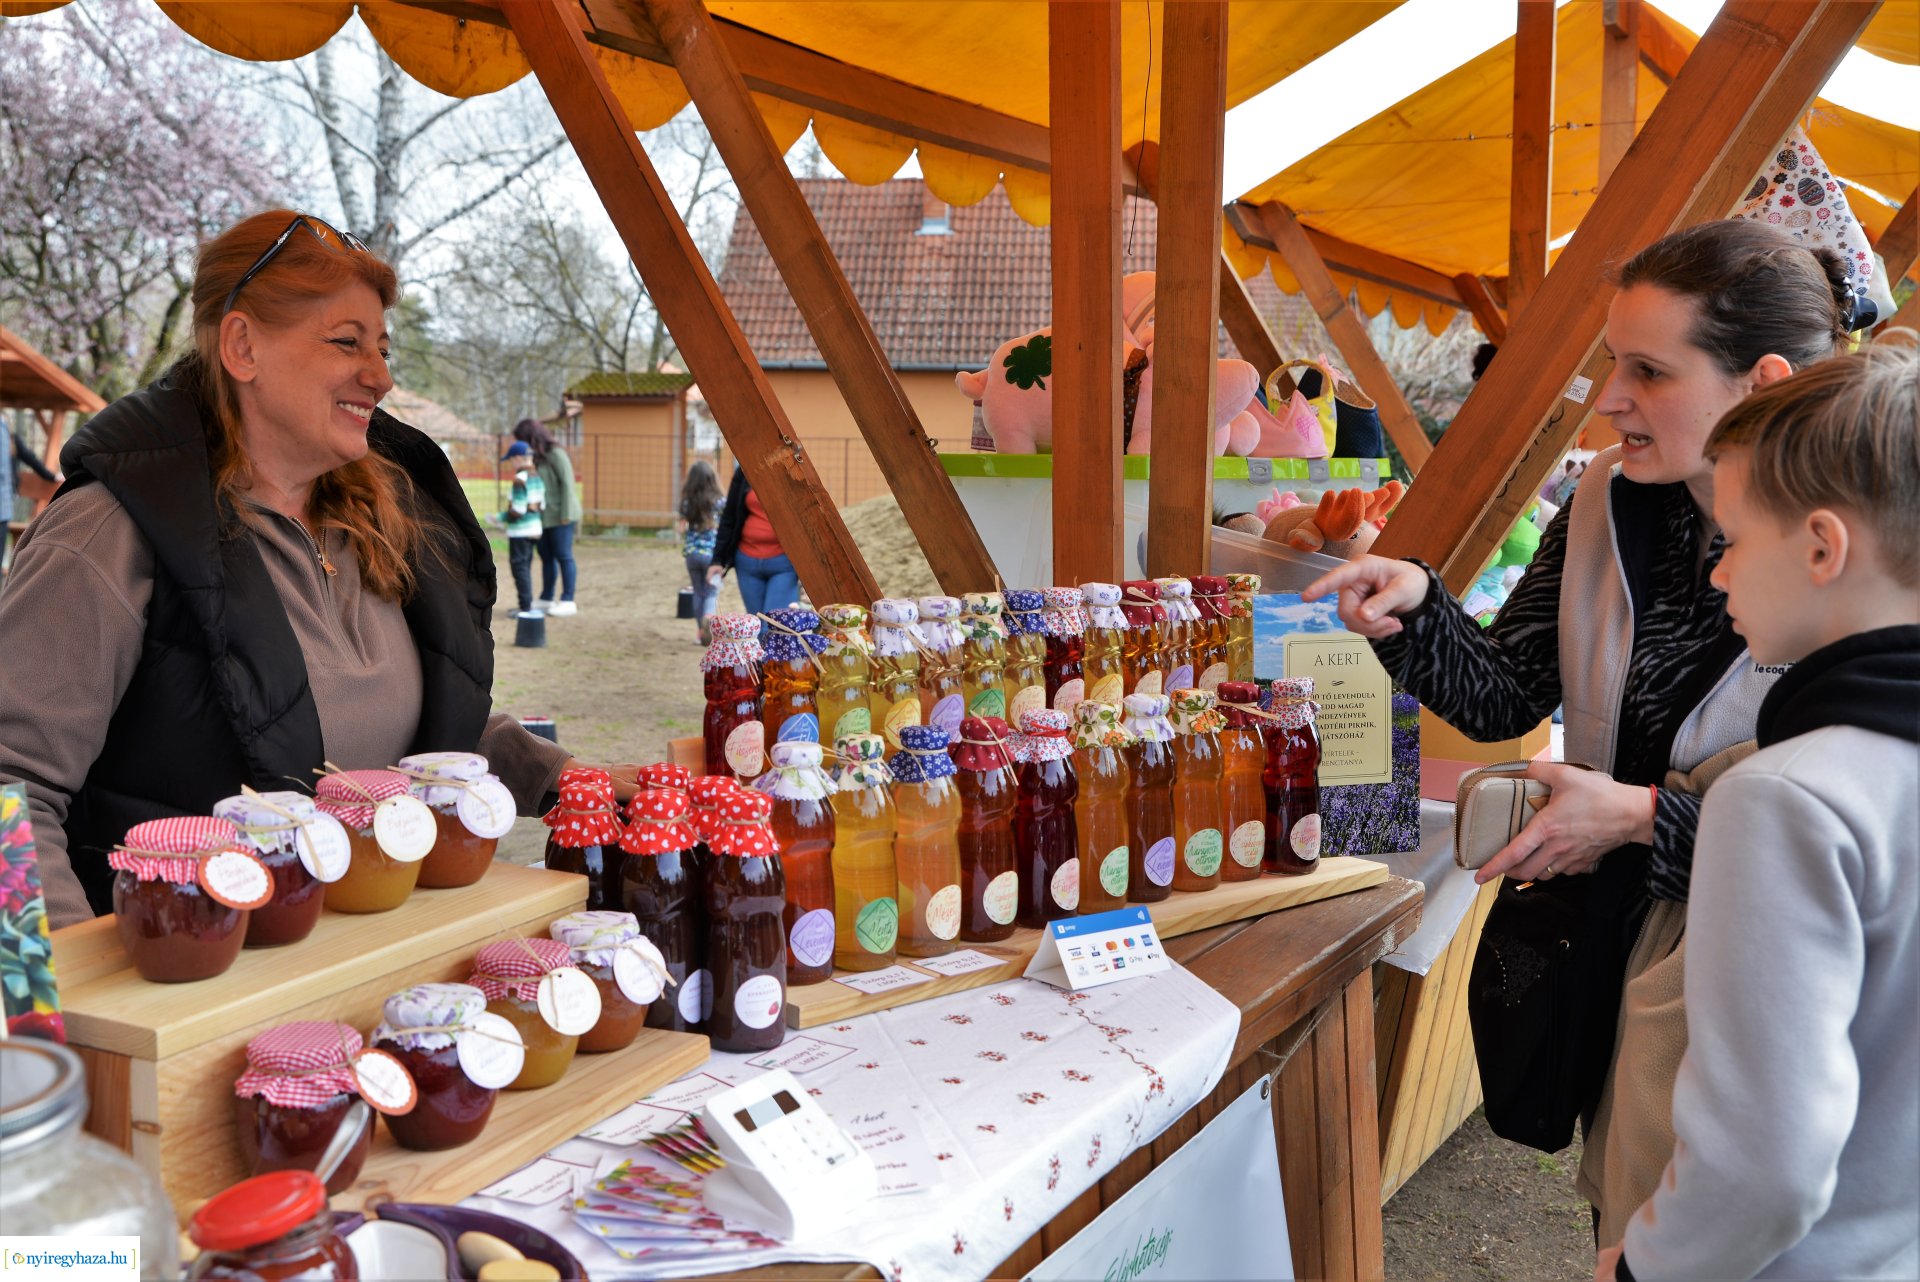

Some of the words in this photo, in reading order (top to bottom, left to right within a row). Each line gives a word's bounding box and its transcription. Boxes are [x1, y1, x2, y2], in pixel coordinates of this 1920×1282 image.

[1314, 654, 1323, 666] A
[1328, 652, 1362, 666] KERT
[1333, 691, 1376, 700] LEVENDULA
[1337, 702, 1365, 710] MAGAD
[1348, 721, 1377, 730] PIKNIK,
[1322, 731, 1365, 742] JÁTSZÓHÁZ
